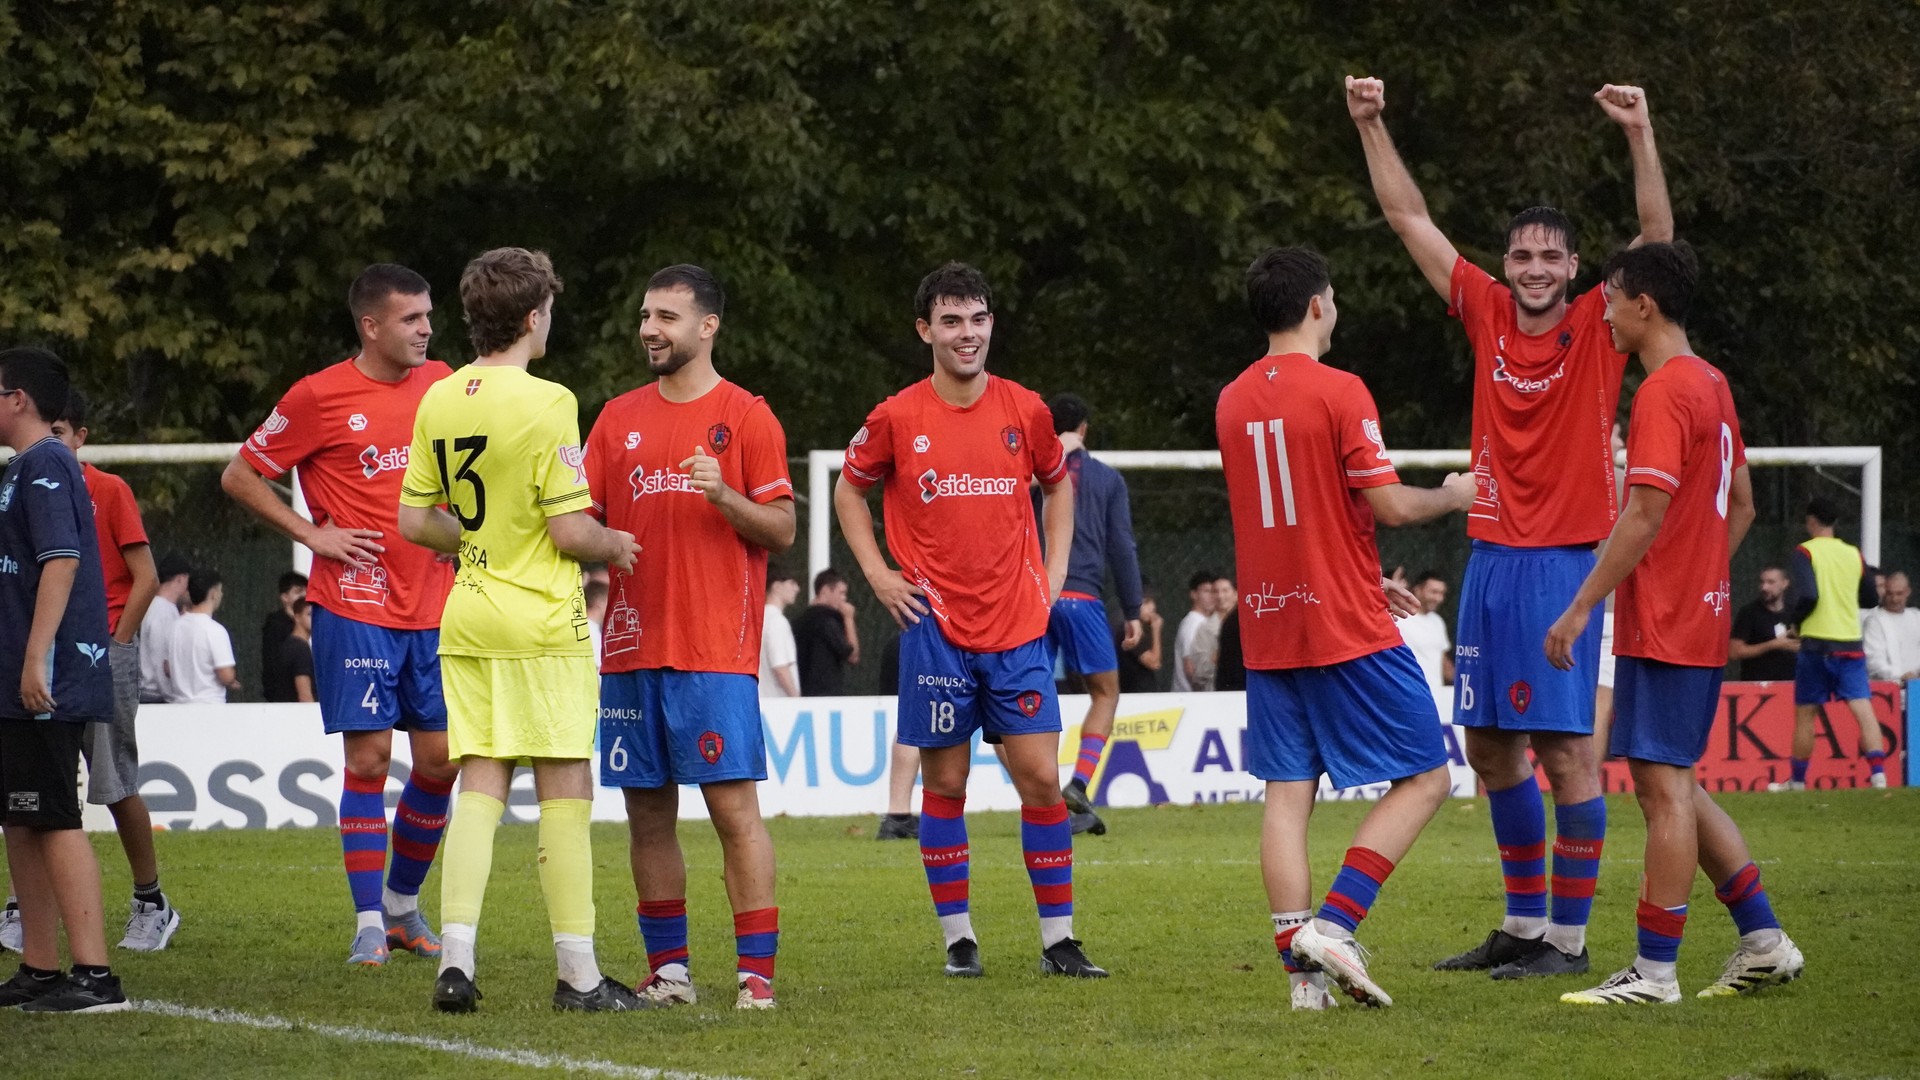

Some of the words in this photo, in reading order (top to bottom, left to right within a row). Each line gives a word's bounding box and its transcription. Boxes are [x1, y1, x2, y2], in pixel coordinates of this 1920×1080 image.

[381, 446, 410, 471] sid
[1247, 418, 1297, 528] 11
[1716, 422, 1733, 520] 8
[433, 436, 487, 531] 13
[345, 658, 389, 669] DOMUSA
[918, 675, 966, 688] DOMUSA
[1460, 673, 1475, 711] 16
[361, 682, 379, 715] 4
[930, 700, 955, 733] 18
[609, 736, 628, 772] 6
[1034, 854, 1073, 864] ANAIT
